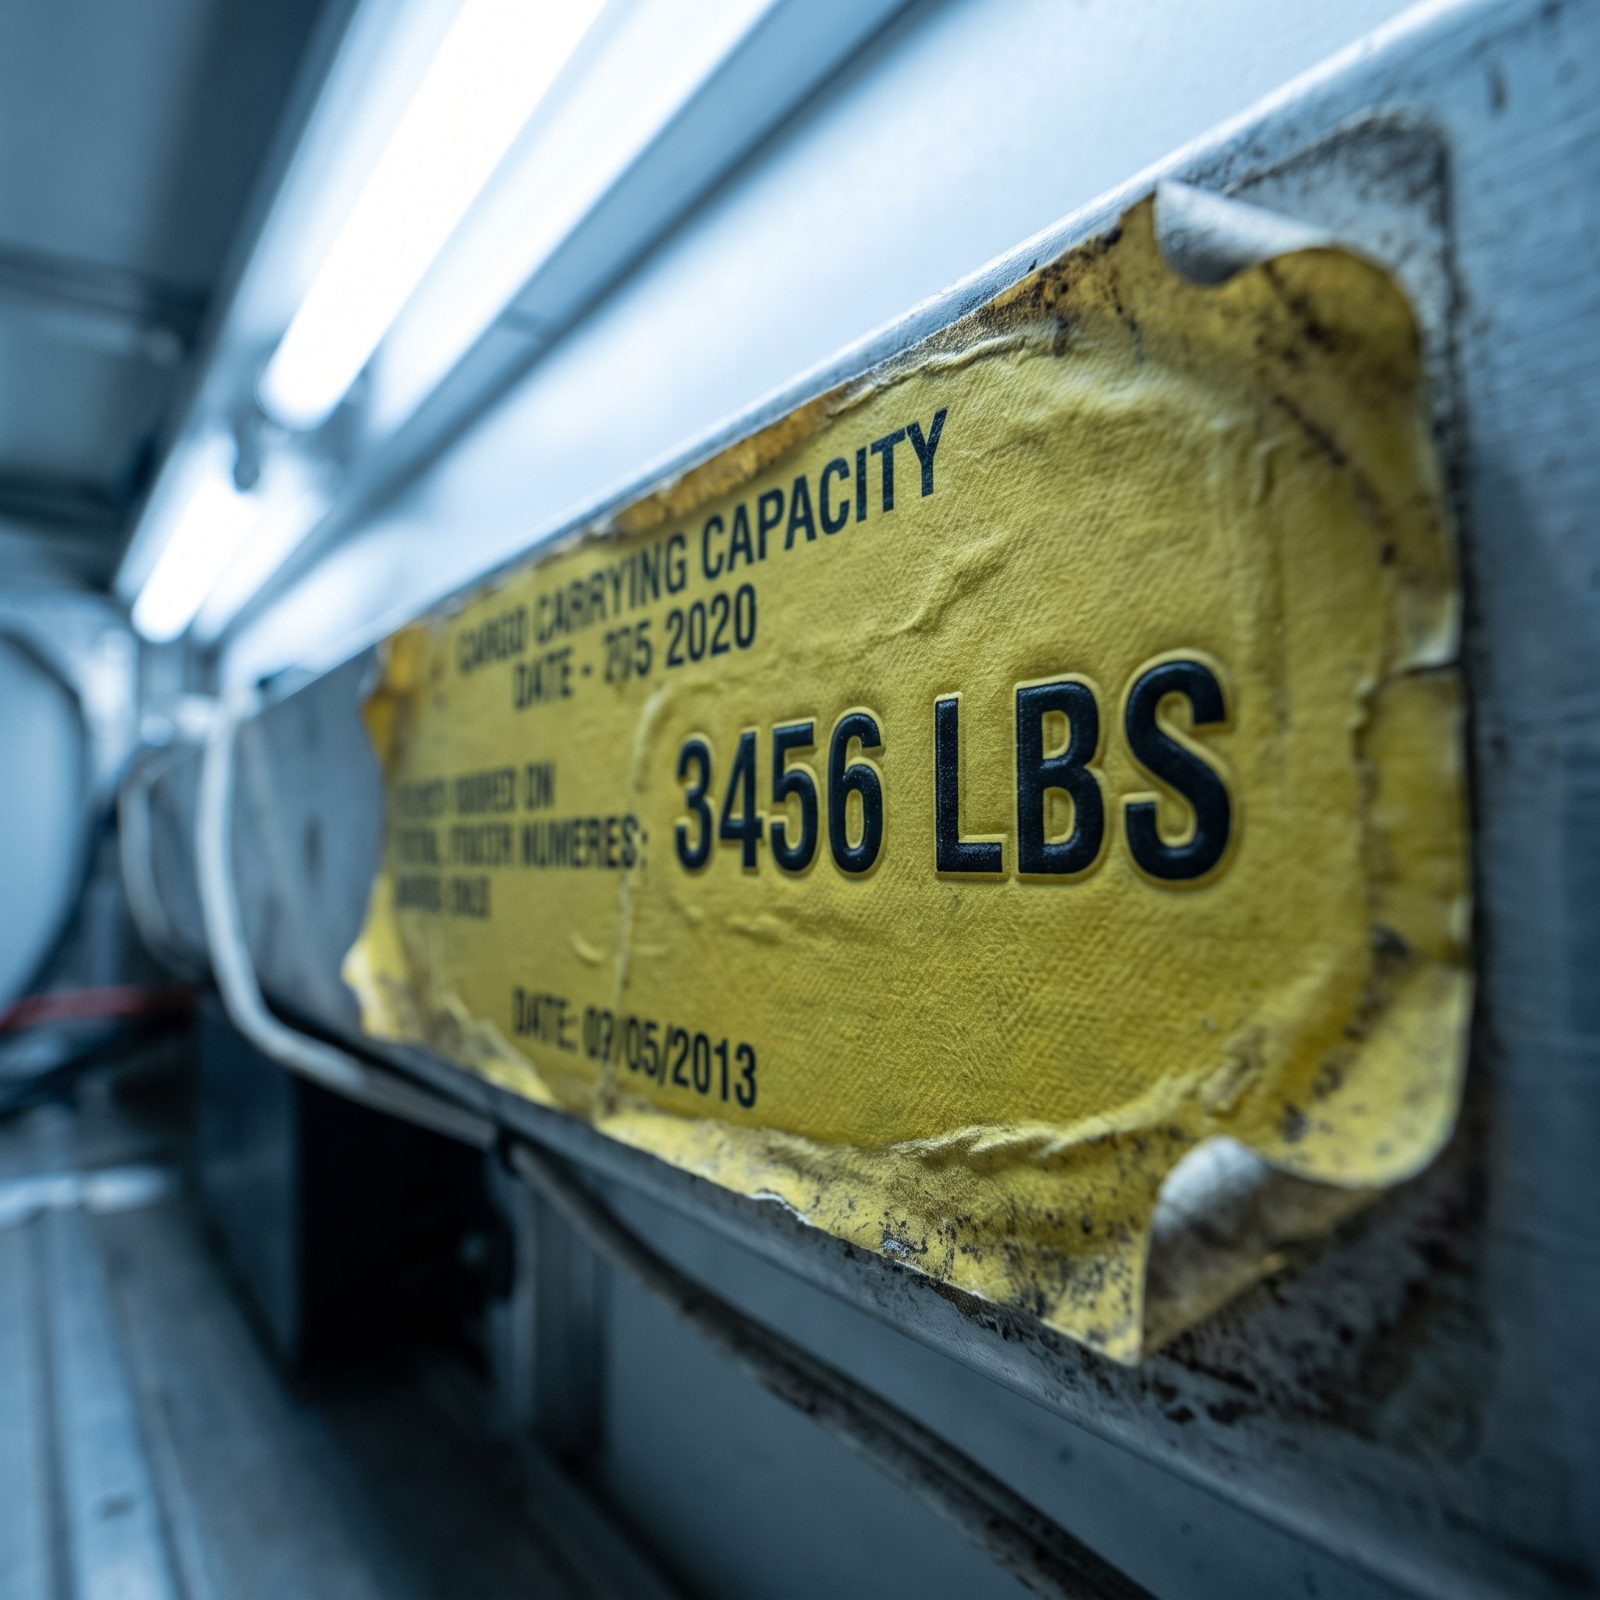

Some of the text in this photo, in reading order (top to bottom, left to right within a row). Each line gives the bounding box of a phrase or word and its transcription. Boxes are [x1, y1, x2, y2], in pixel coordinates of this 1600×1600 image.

[534, 533, 687, 643] CARRYING
[702, 408, 948, 580] CAPACITY
[666, 583, 757, 668] 2020
[674, 659, 1231, 882] 3456 LBS
